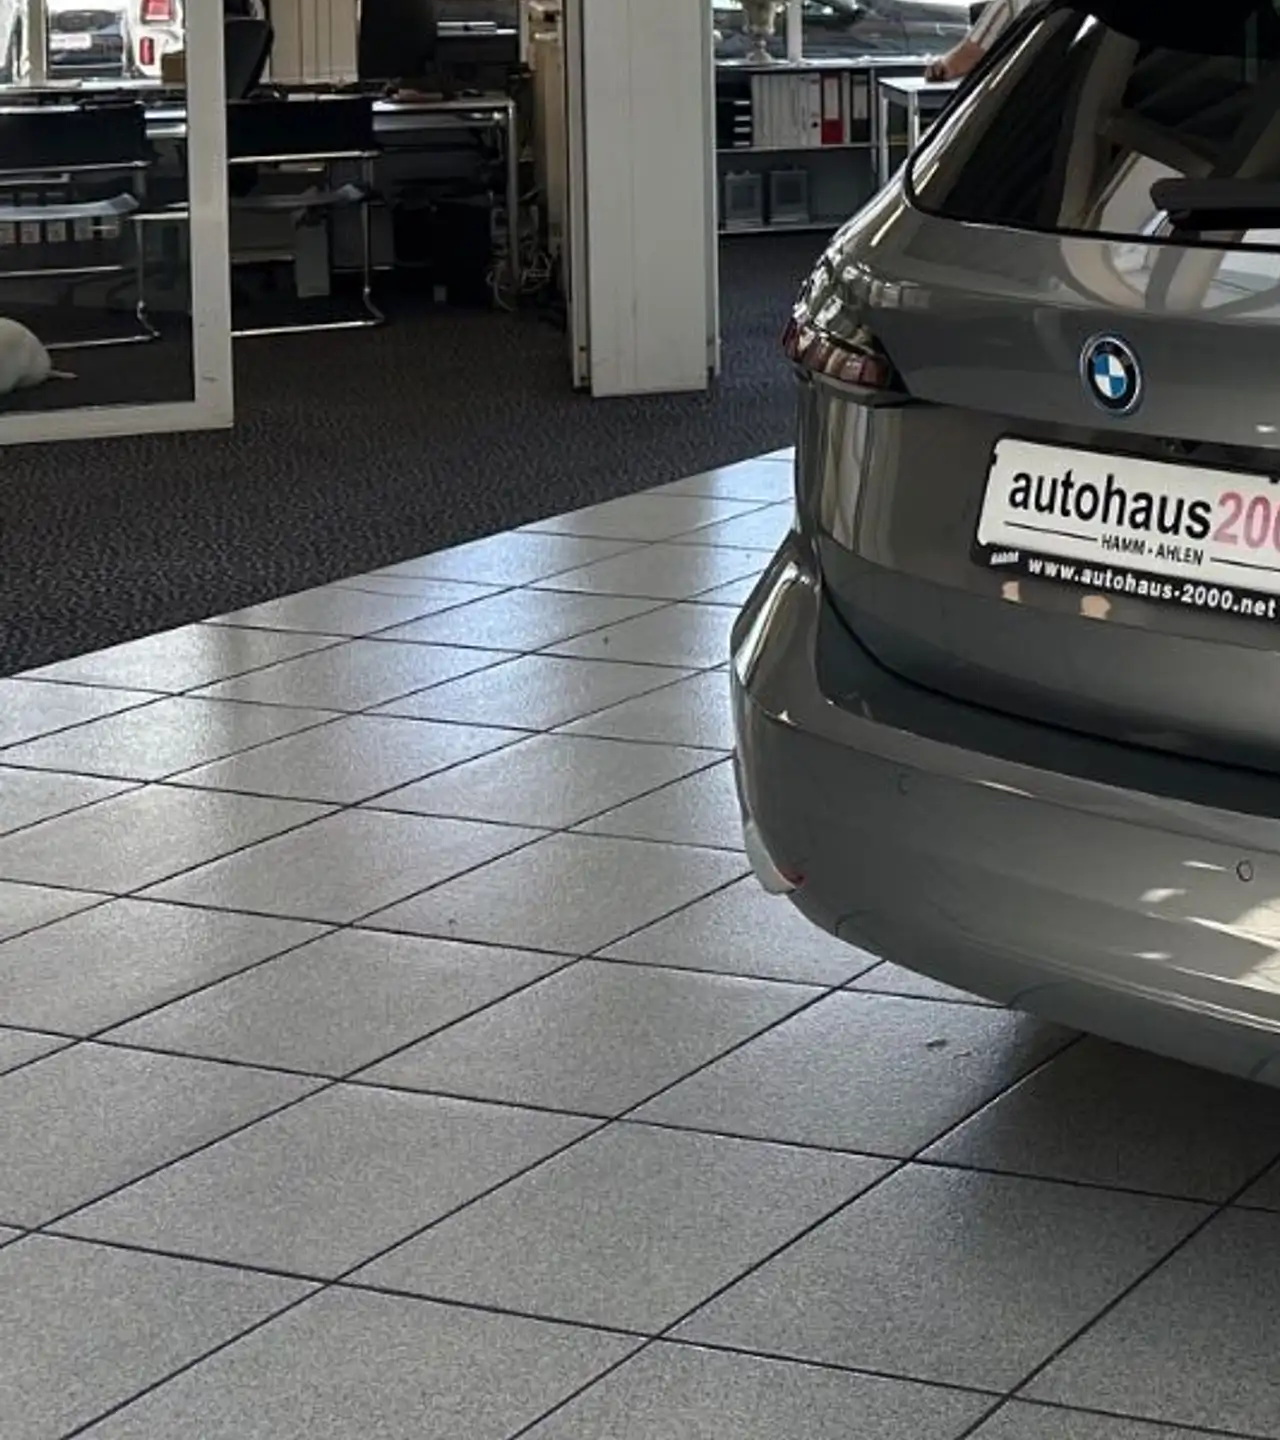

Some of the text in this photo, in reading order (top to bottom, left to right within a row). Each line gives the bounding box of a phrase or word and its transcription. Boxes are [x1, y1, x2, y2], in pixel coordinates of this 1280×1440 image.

[1101, 533, 1145, 556] HAMM
[1155, 542, 1204, 565] AHLEN
[1028, 558, 1276, 618] www.autohaus-2000.net
